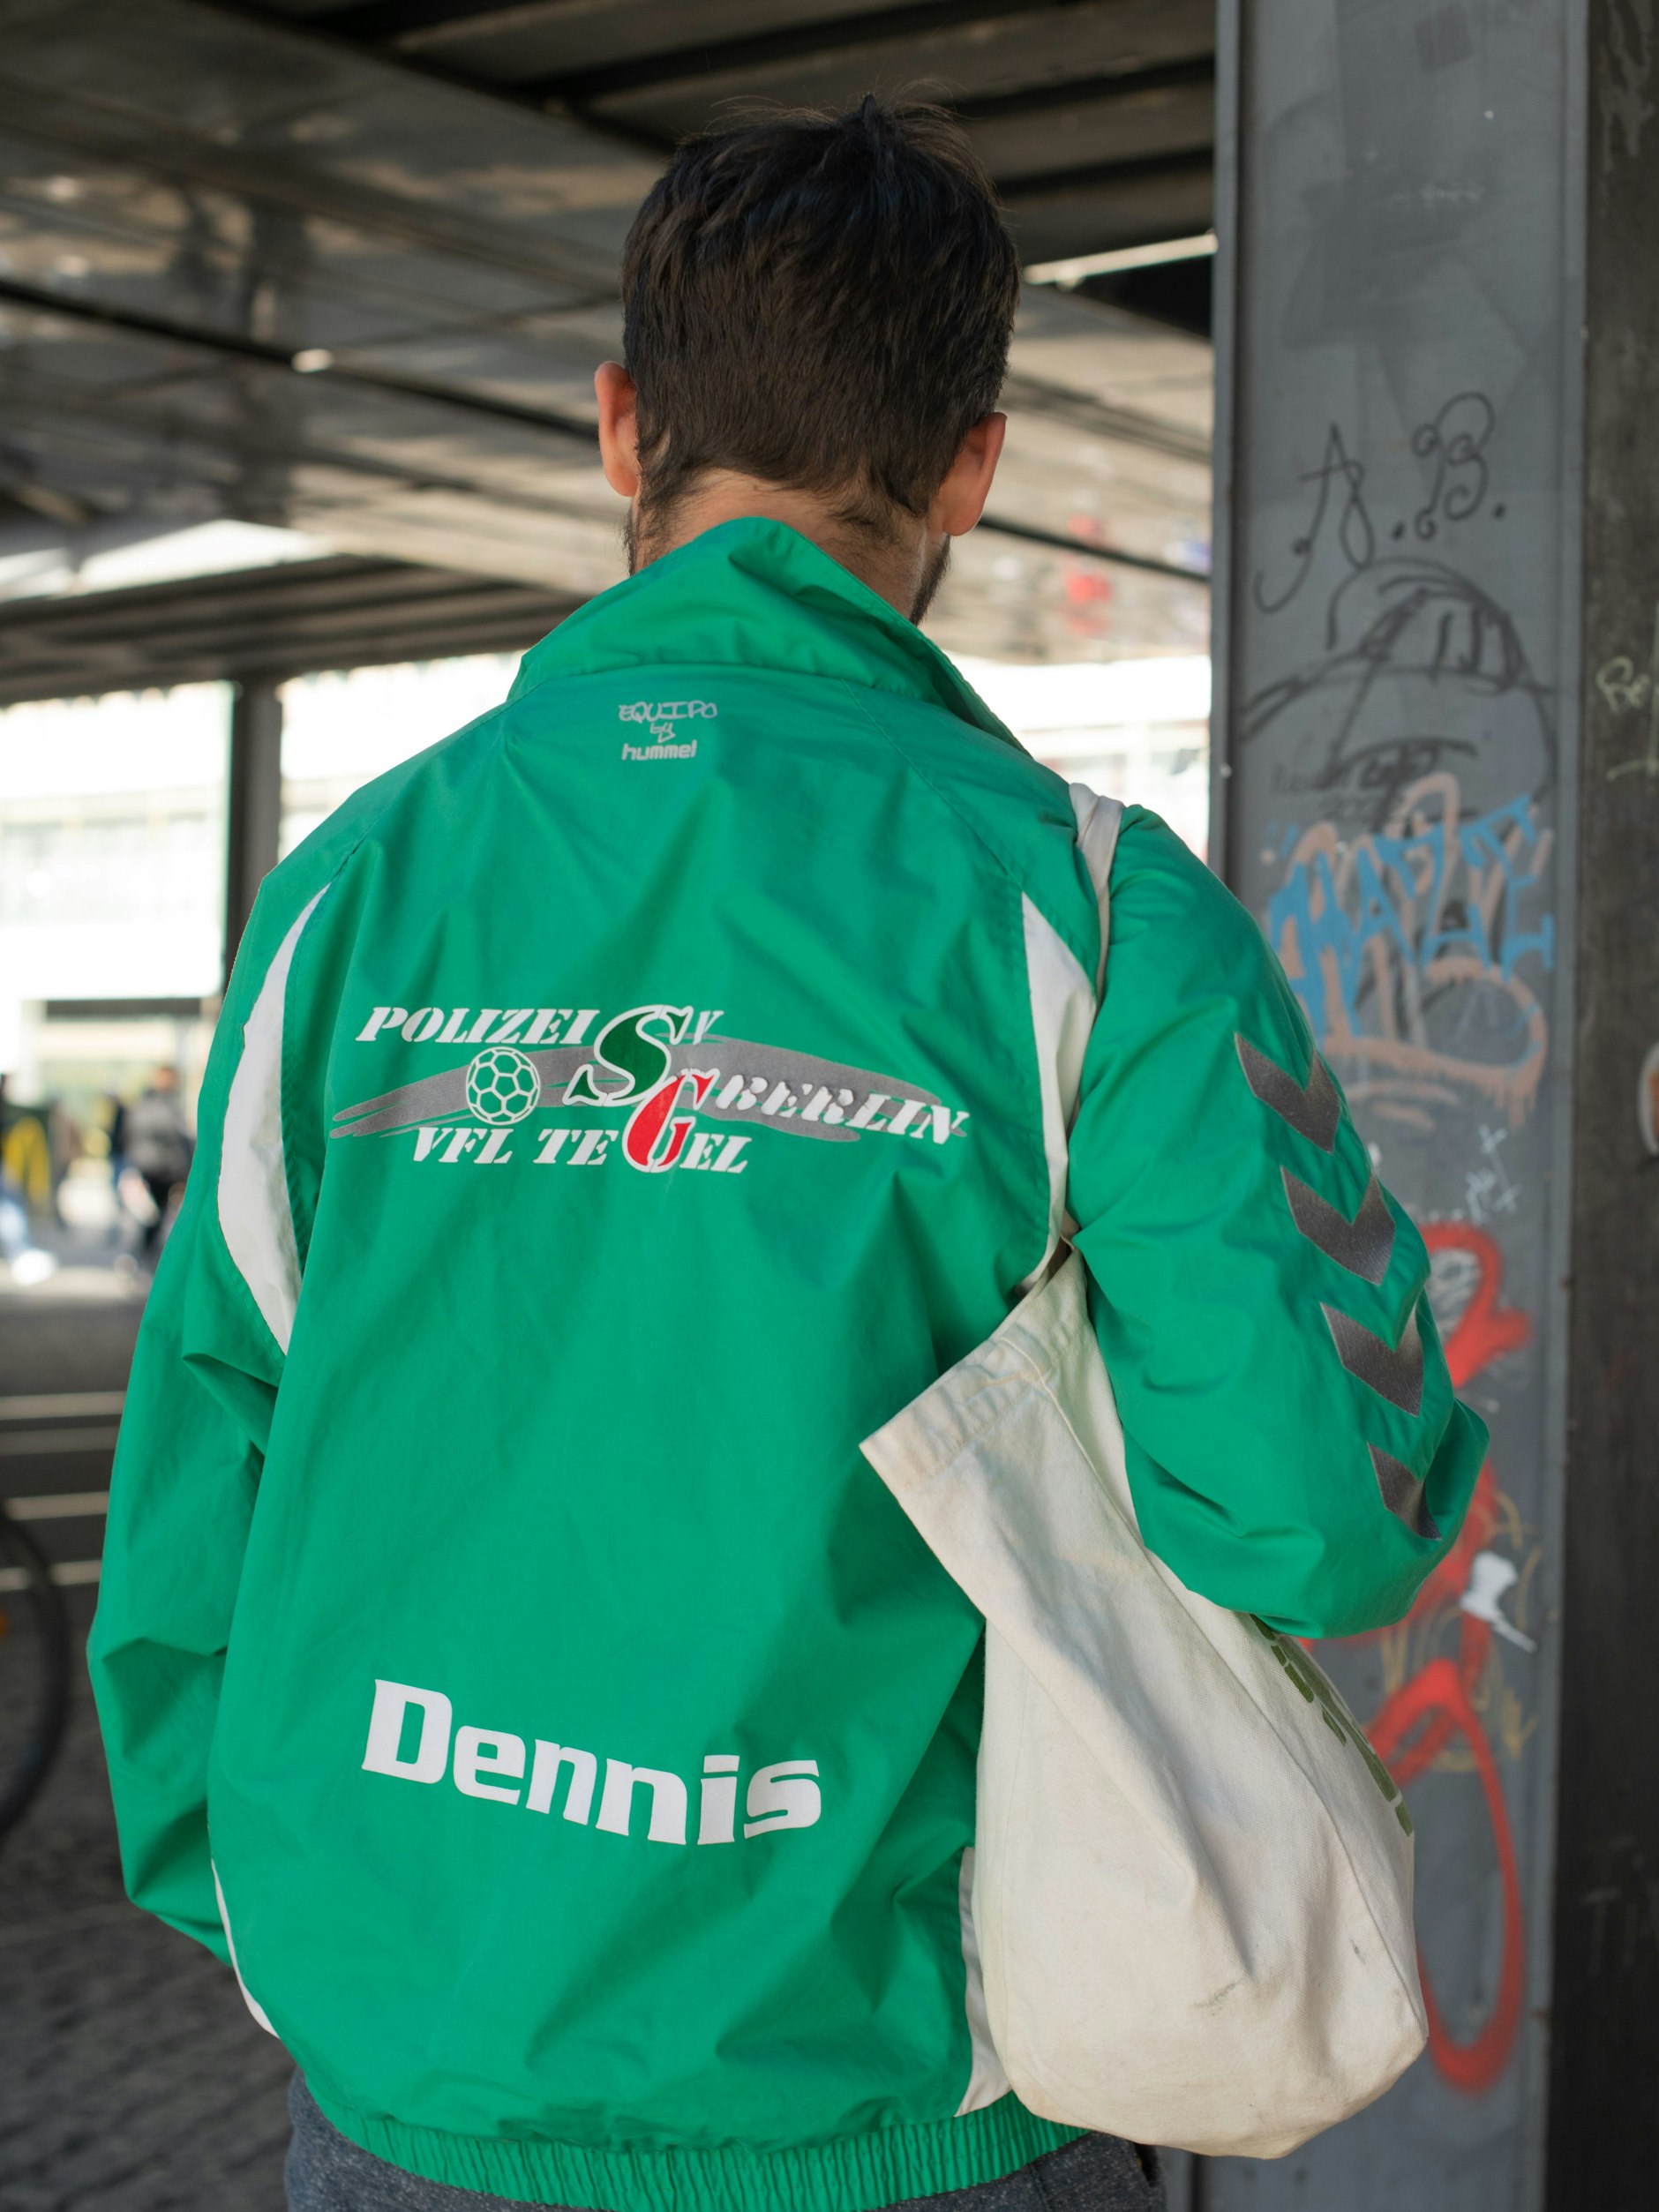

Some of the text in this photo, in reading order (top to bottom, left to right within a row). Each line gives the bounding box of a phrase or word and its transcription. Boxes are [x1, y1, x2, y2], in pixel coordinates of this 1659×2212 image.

[619, 700, 718, 724] EQUIPO
[649, 722, 676, 744] by
[620, 739, 698, 761] hummel
[355, 1006, 600, 1045] POLIZEI
[715, 1074, 970, 1144] BERLIN
[412, 1126, 514, 1165] VFL
[361, 1678, 822, 1846] Dennis
